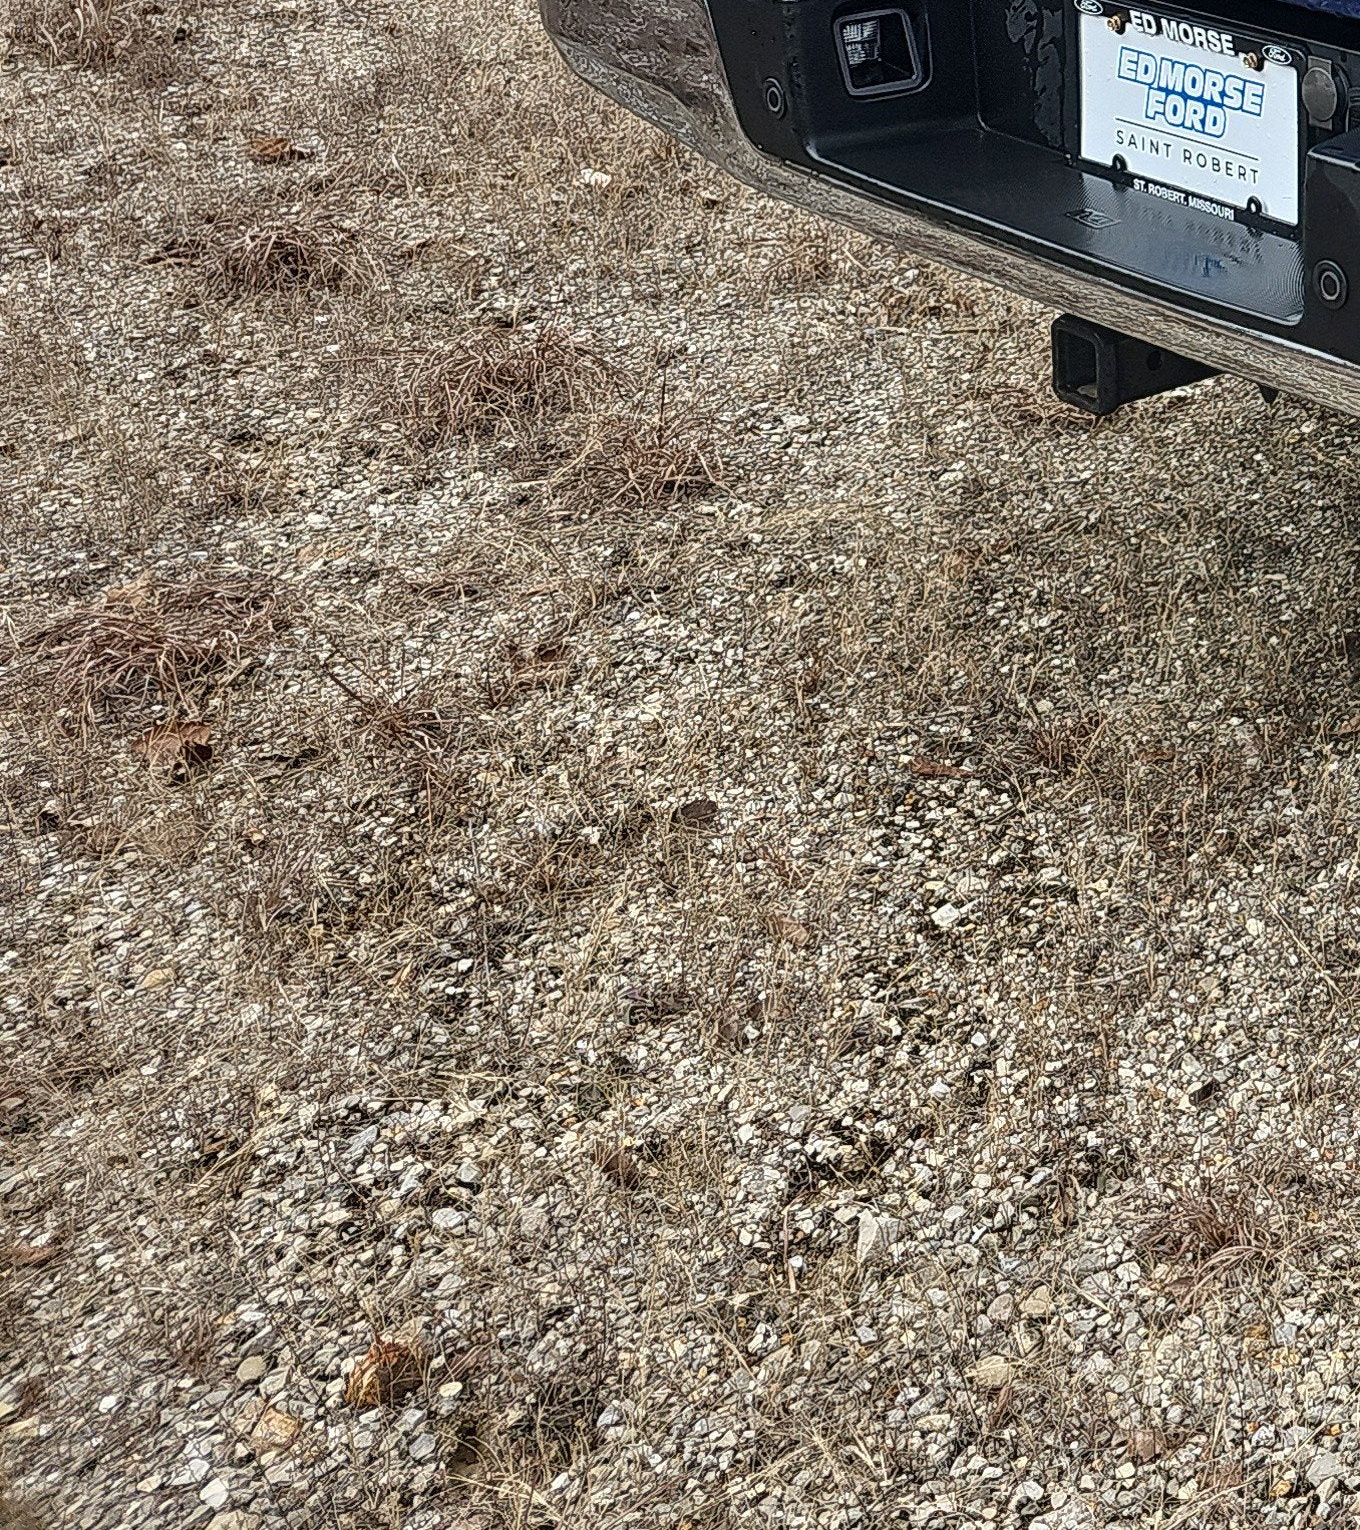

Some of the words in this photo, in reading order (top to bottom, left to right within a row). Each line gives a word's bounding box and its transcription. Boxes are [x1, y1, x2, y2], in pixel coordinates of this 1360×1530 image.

[1129, 10, 1157, 35] ED
[1160, 18, 1237, 56] MORSE
[1156, 57, 1265, 117] MORSE
[1145, 89, 1227, 138] FORD
[1116, 130, 1172, 158] SAINT
[1183, 148, 1259, 184] ROBERT
[1133, 178, 1147, 192] ST.
[1188, 195, 1235, 221] MISSOURI
